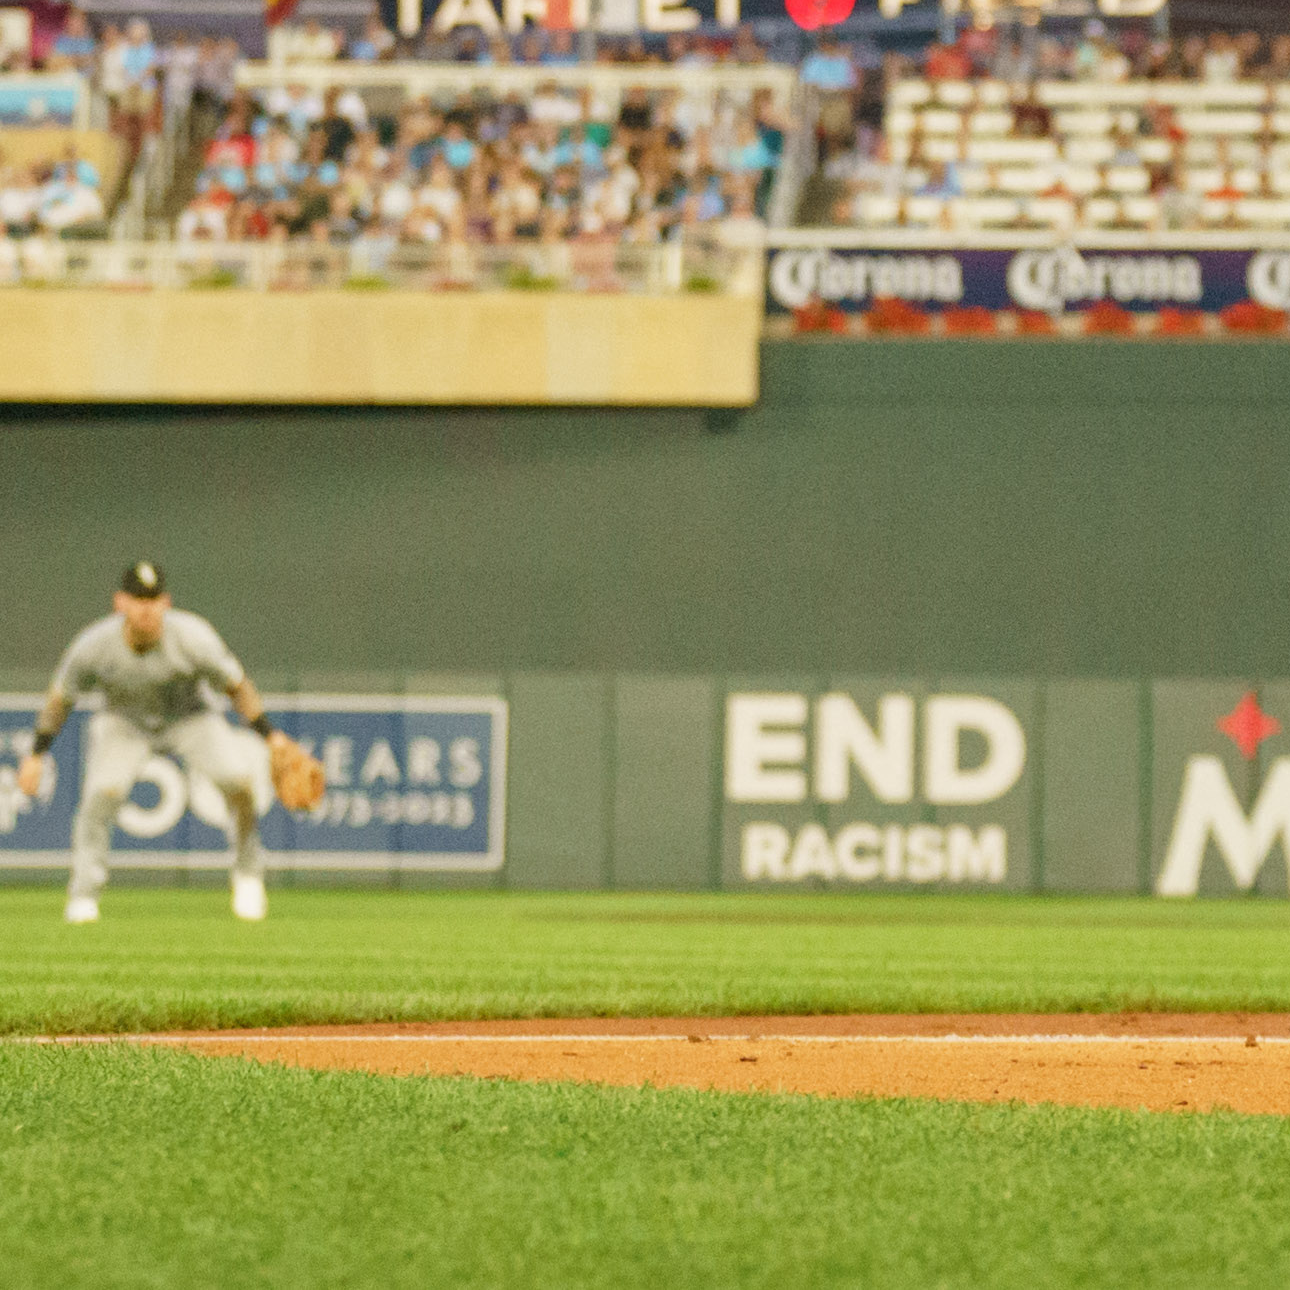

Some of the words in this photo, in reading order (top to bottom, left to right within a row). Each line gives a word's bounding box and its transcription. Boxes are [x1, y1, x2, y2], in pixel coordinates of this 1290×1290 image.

[769, 247, 963, 312] Corona
[1007, 247, 1203, 313] Corona
[298, 735, 483, 787] EARS
[724, 691, 1026, 804] END
[741, 822, 1007, 883] RACISM
